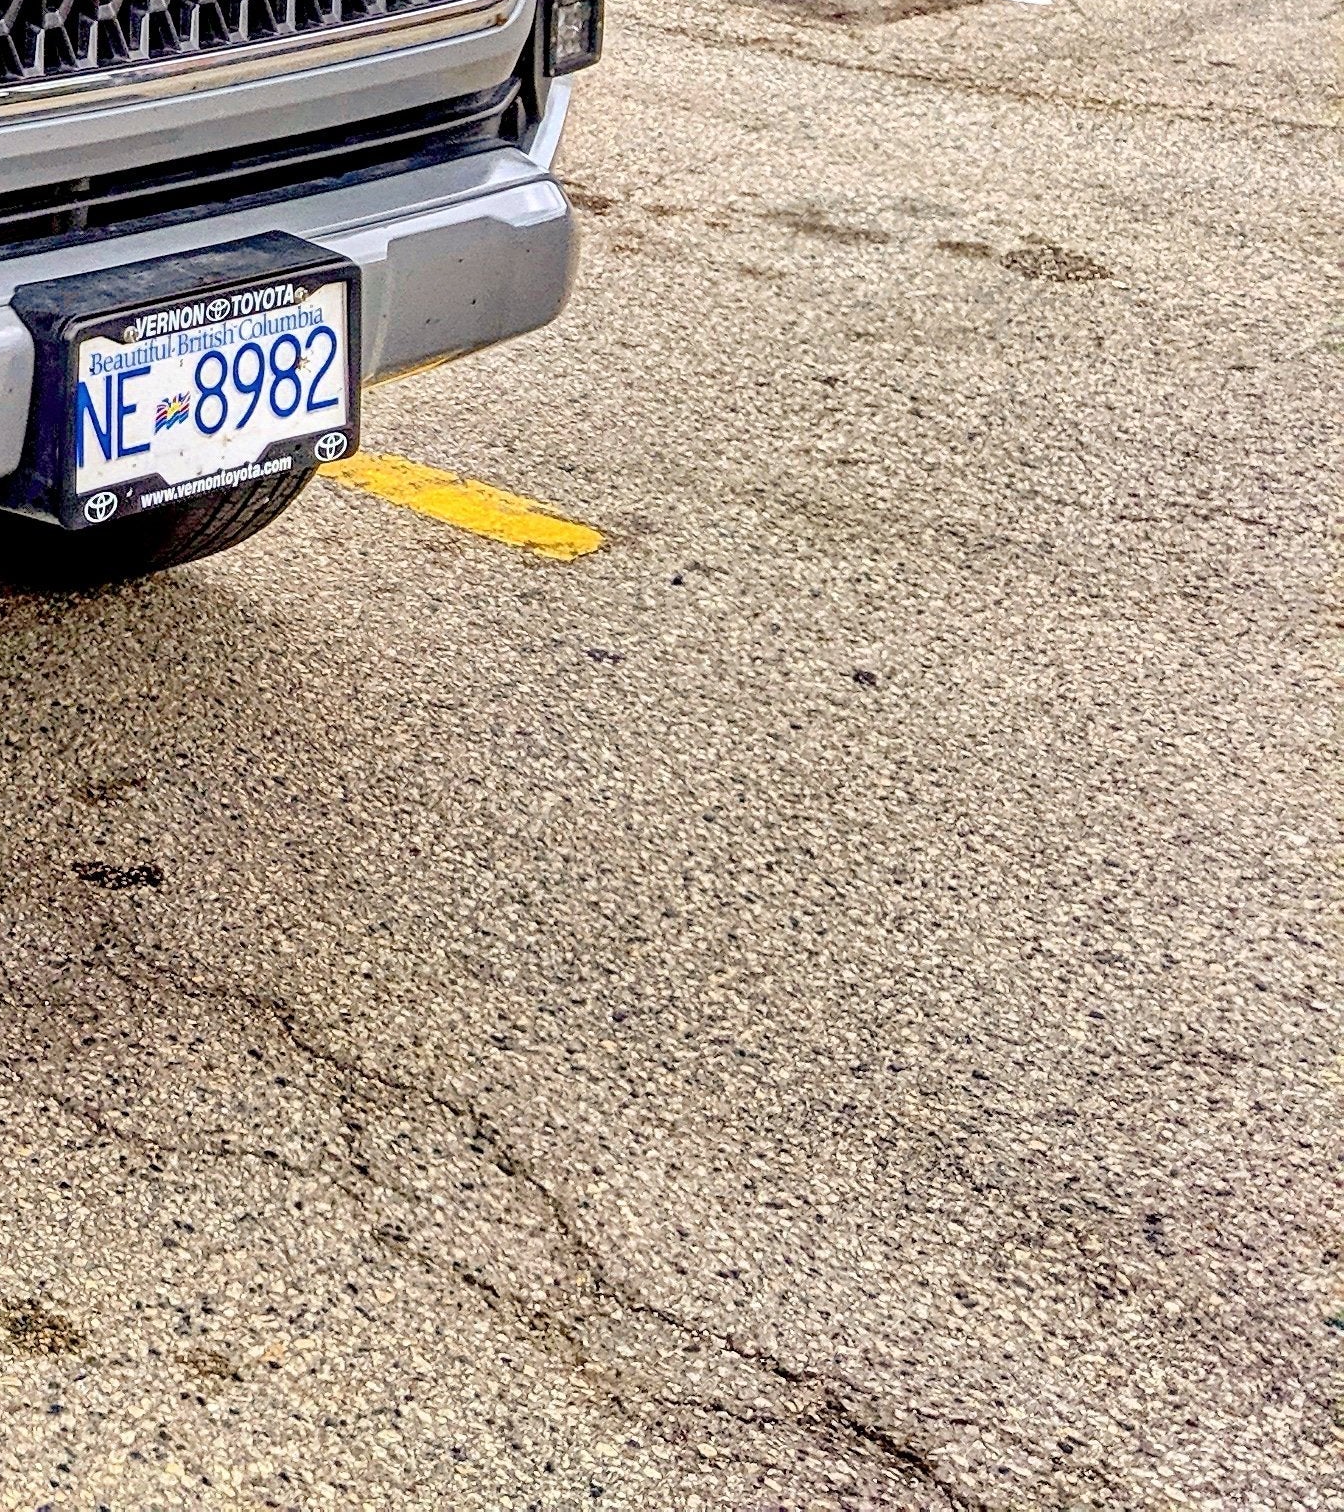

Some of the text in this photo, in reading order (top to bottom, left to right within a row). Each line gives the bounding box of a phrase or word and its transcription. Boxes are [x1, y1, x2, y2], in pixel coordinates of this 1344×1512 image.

[89, 304, 324, 376] Beautiful British Columbia
[135, 284, 295, 340] VERNON TOYOTA
[77, 325, 340, 468] NE 8982
[140, 455, 293, 509] www.vernontoyota.com
